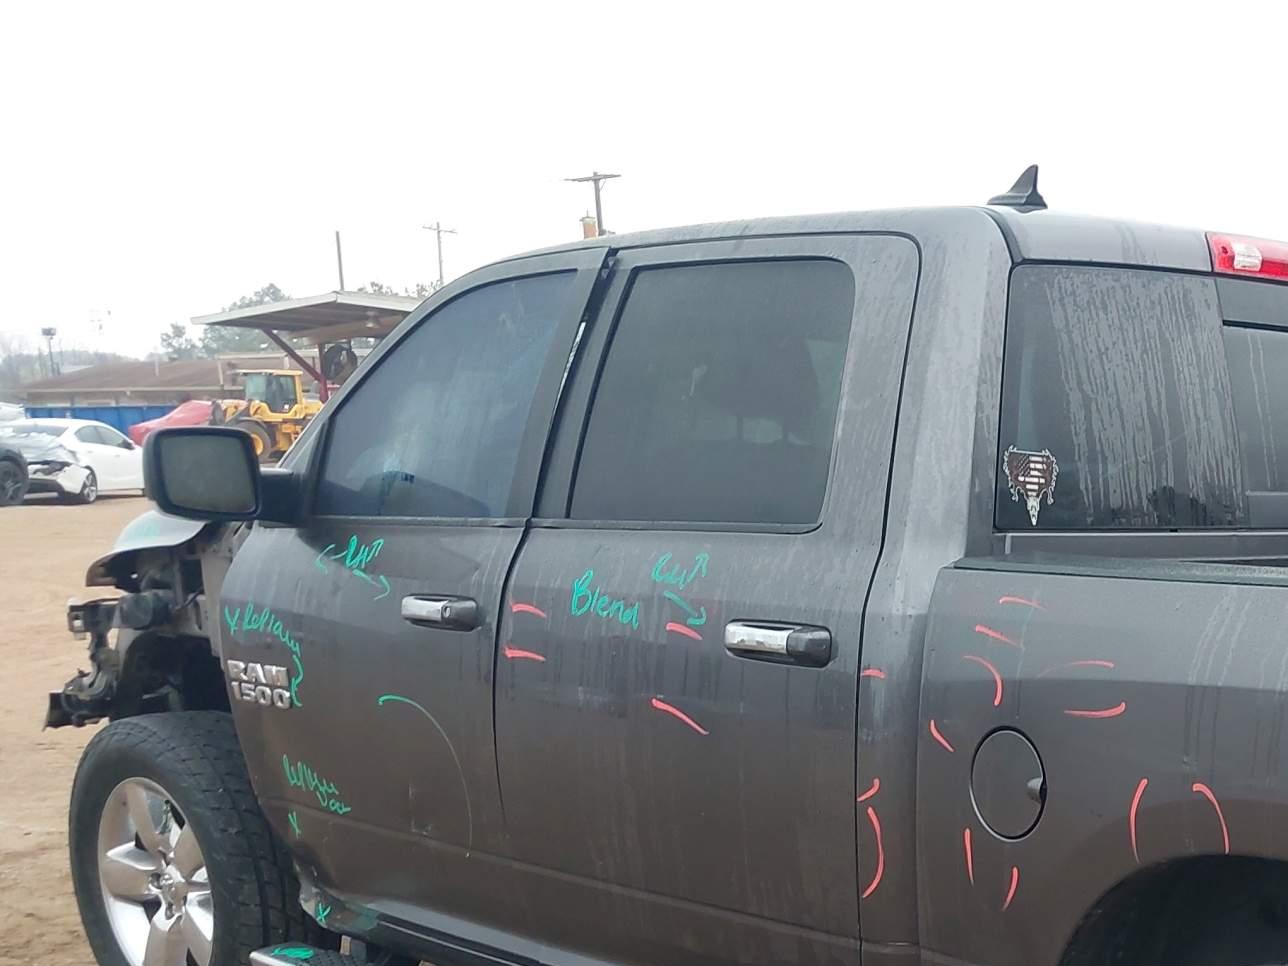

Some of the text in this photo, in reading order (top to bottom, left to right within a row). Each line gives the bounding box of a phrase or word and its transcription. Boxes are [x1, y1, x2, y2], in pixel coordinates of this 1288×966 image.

[571, 567, 640, 630] Blend
[227, 659, 289, 687] RAM
[231, 681, 291, 709] 1500
